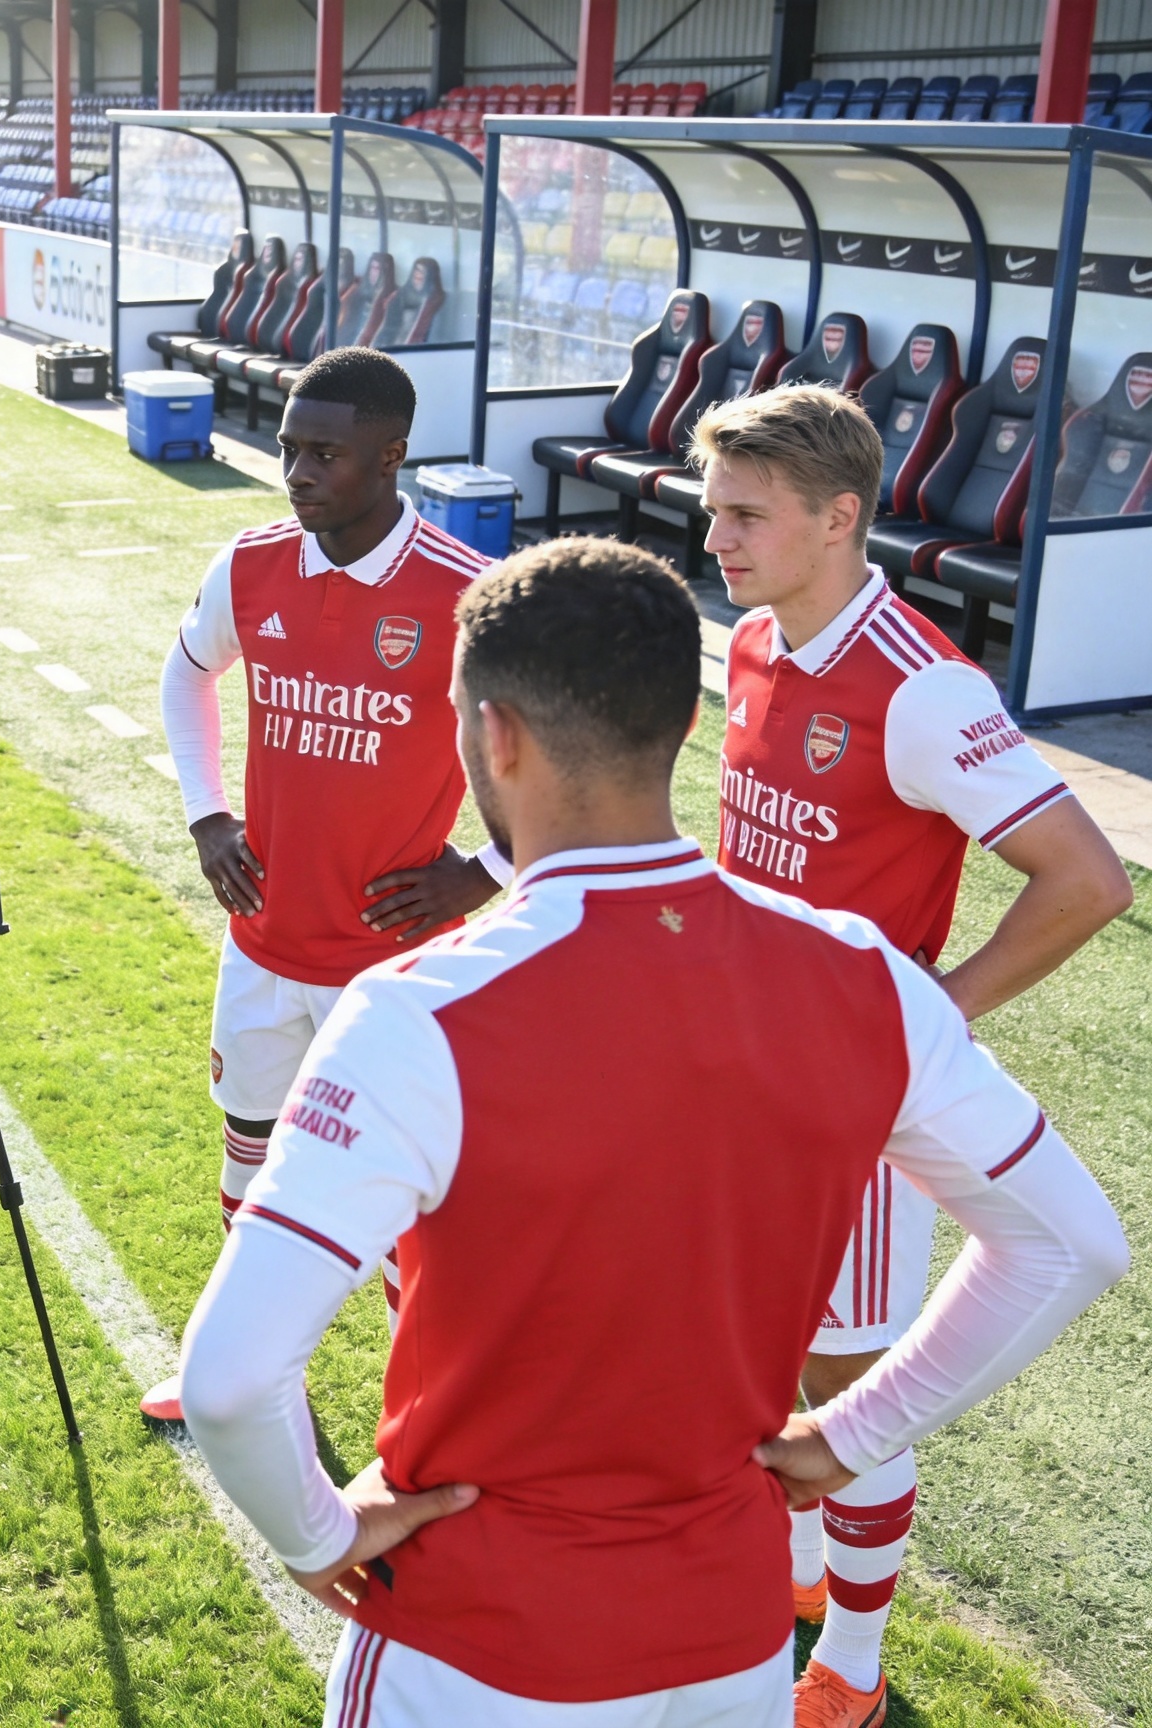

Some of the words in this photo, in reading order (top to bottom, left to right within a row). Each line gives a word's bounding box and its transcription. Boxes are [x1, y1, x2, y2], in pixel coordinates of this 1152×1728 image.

[251, 662, 412, 726] Emirates
[264, 713, 293, 750] FLY
[298, 719, 381, 766] BETTER
